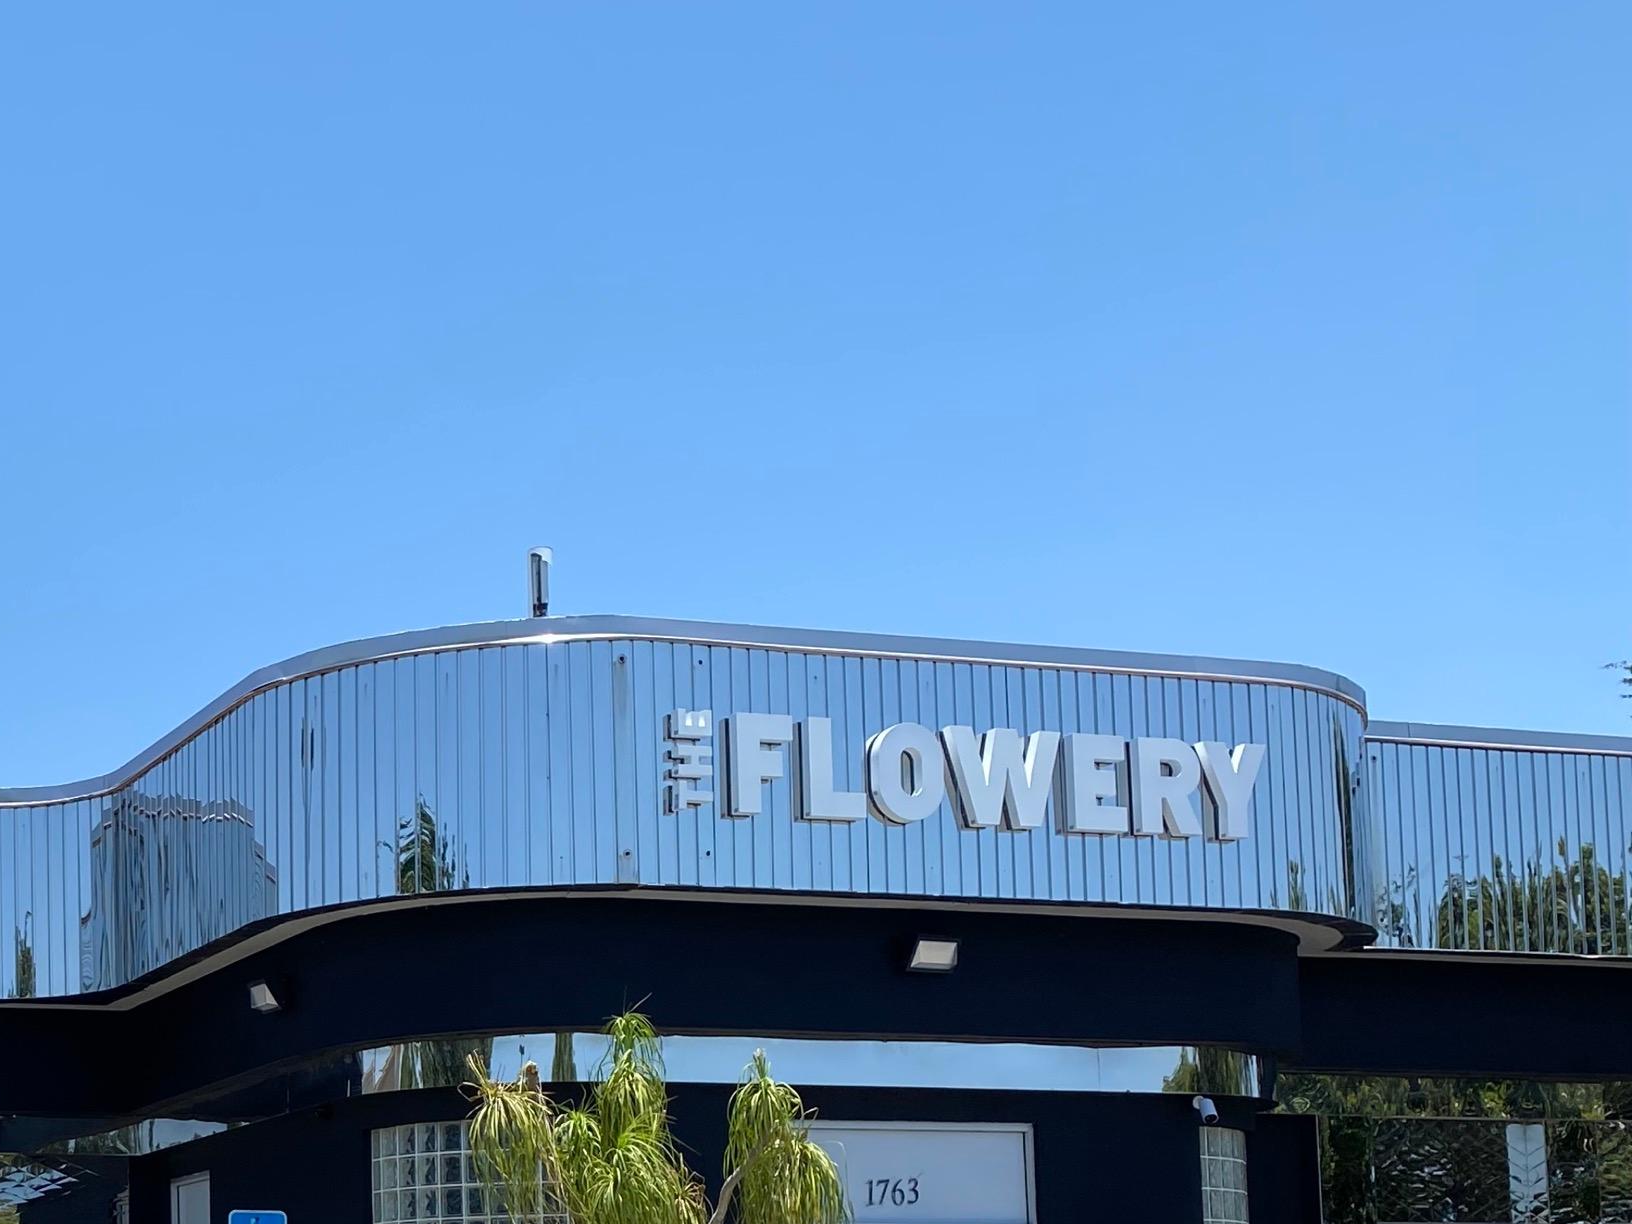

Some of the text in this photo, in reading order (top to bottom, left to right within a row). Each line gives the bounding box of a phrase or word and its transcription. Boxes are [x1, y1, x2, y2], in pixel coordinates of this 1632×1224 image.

[664, 708, 1265, 843] THE FLOWERY
[865, 1178, 919, 1207] 1763
